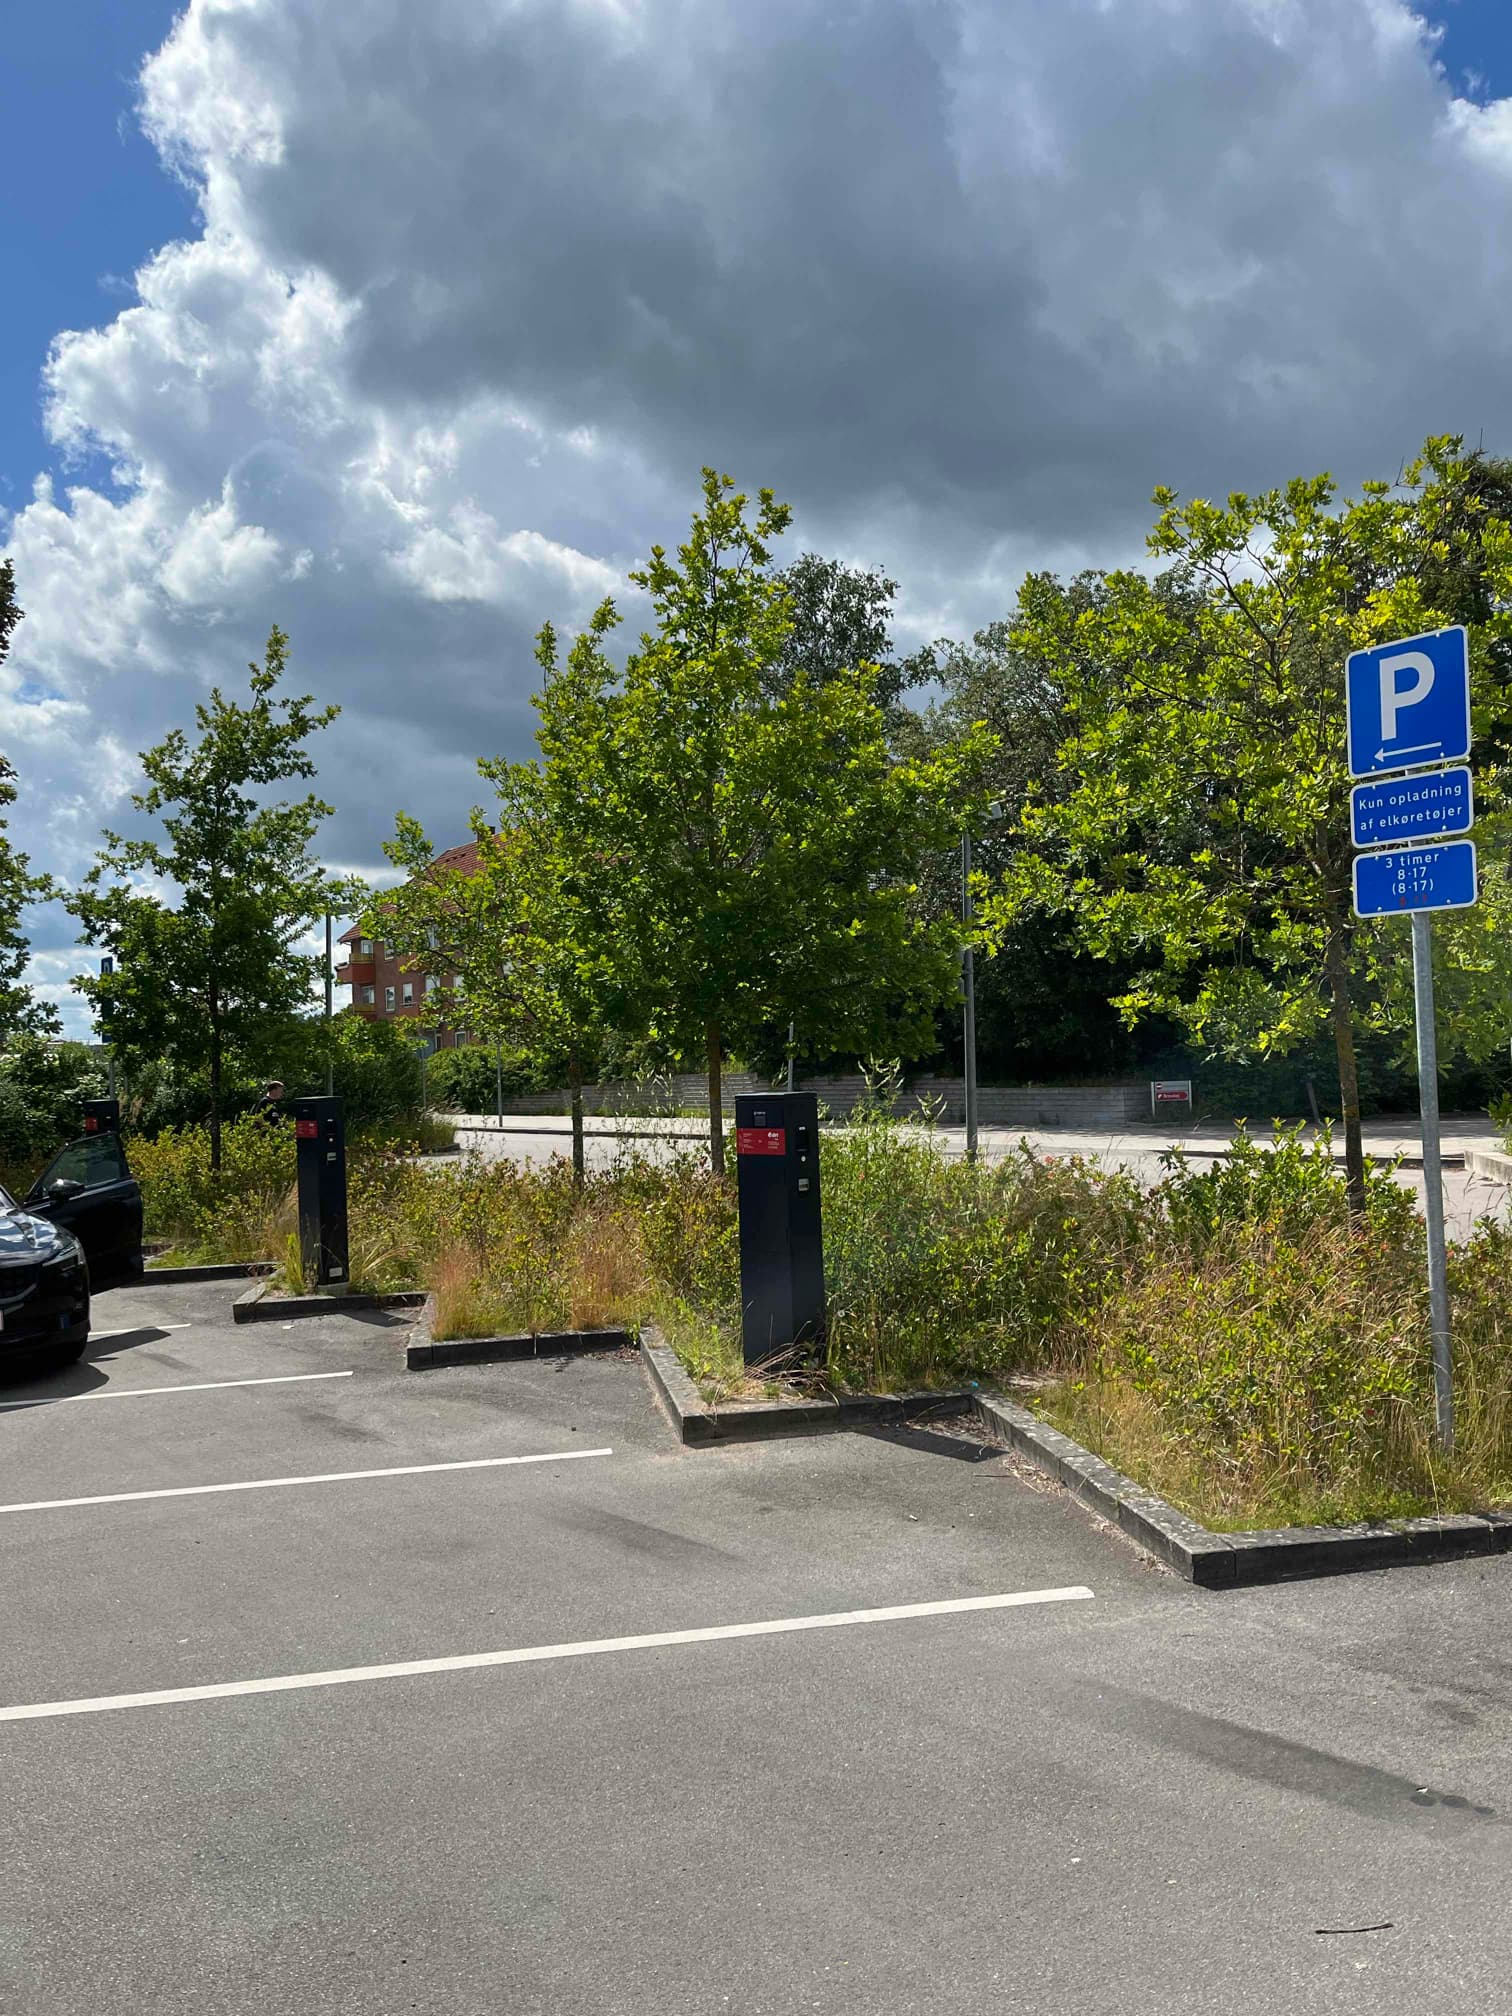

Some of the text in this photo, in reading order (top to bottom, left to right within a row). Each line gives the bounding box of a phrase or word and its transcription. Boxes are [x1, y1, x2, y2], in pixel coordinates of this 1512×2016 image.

[1379, 651, 1435, 741] P
[1359, 785, 1462, 811] Kun opladning
[1360, 806, 1463, 831] af elkøretøjer
[1385, 854, 1440, 869] 3 timer
[1397, 866, 1427, 880] 8-17
[1392, 878, 1434, 896] (8-17)
